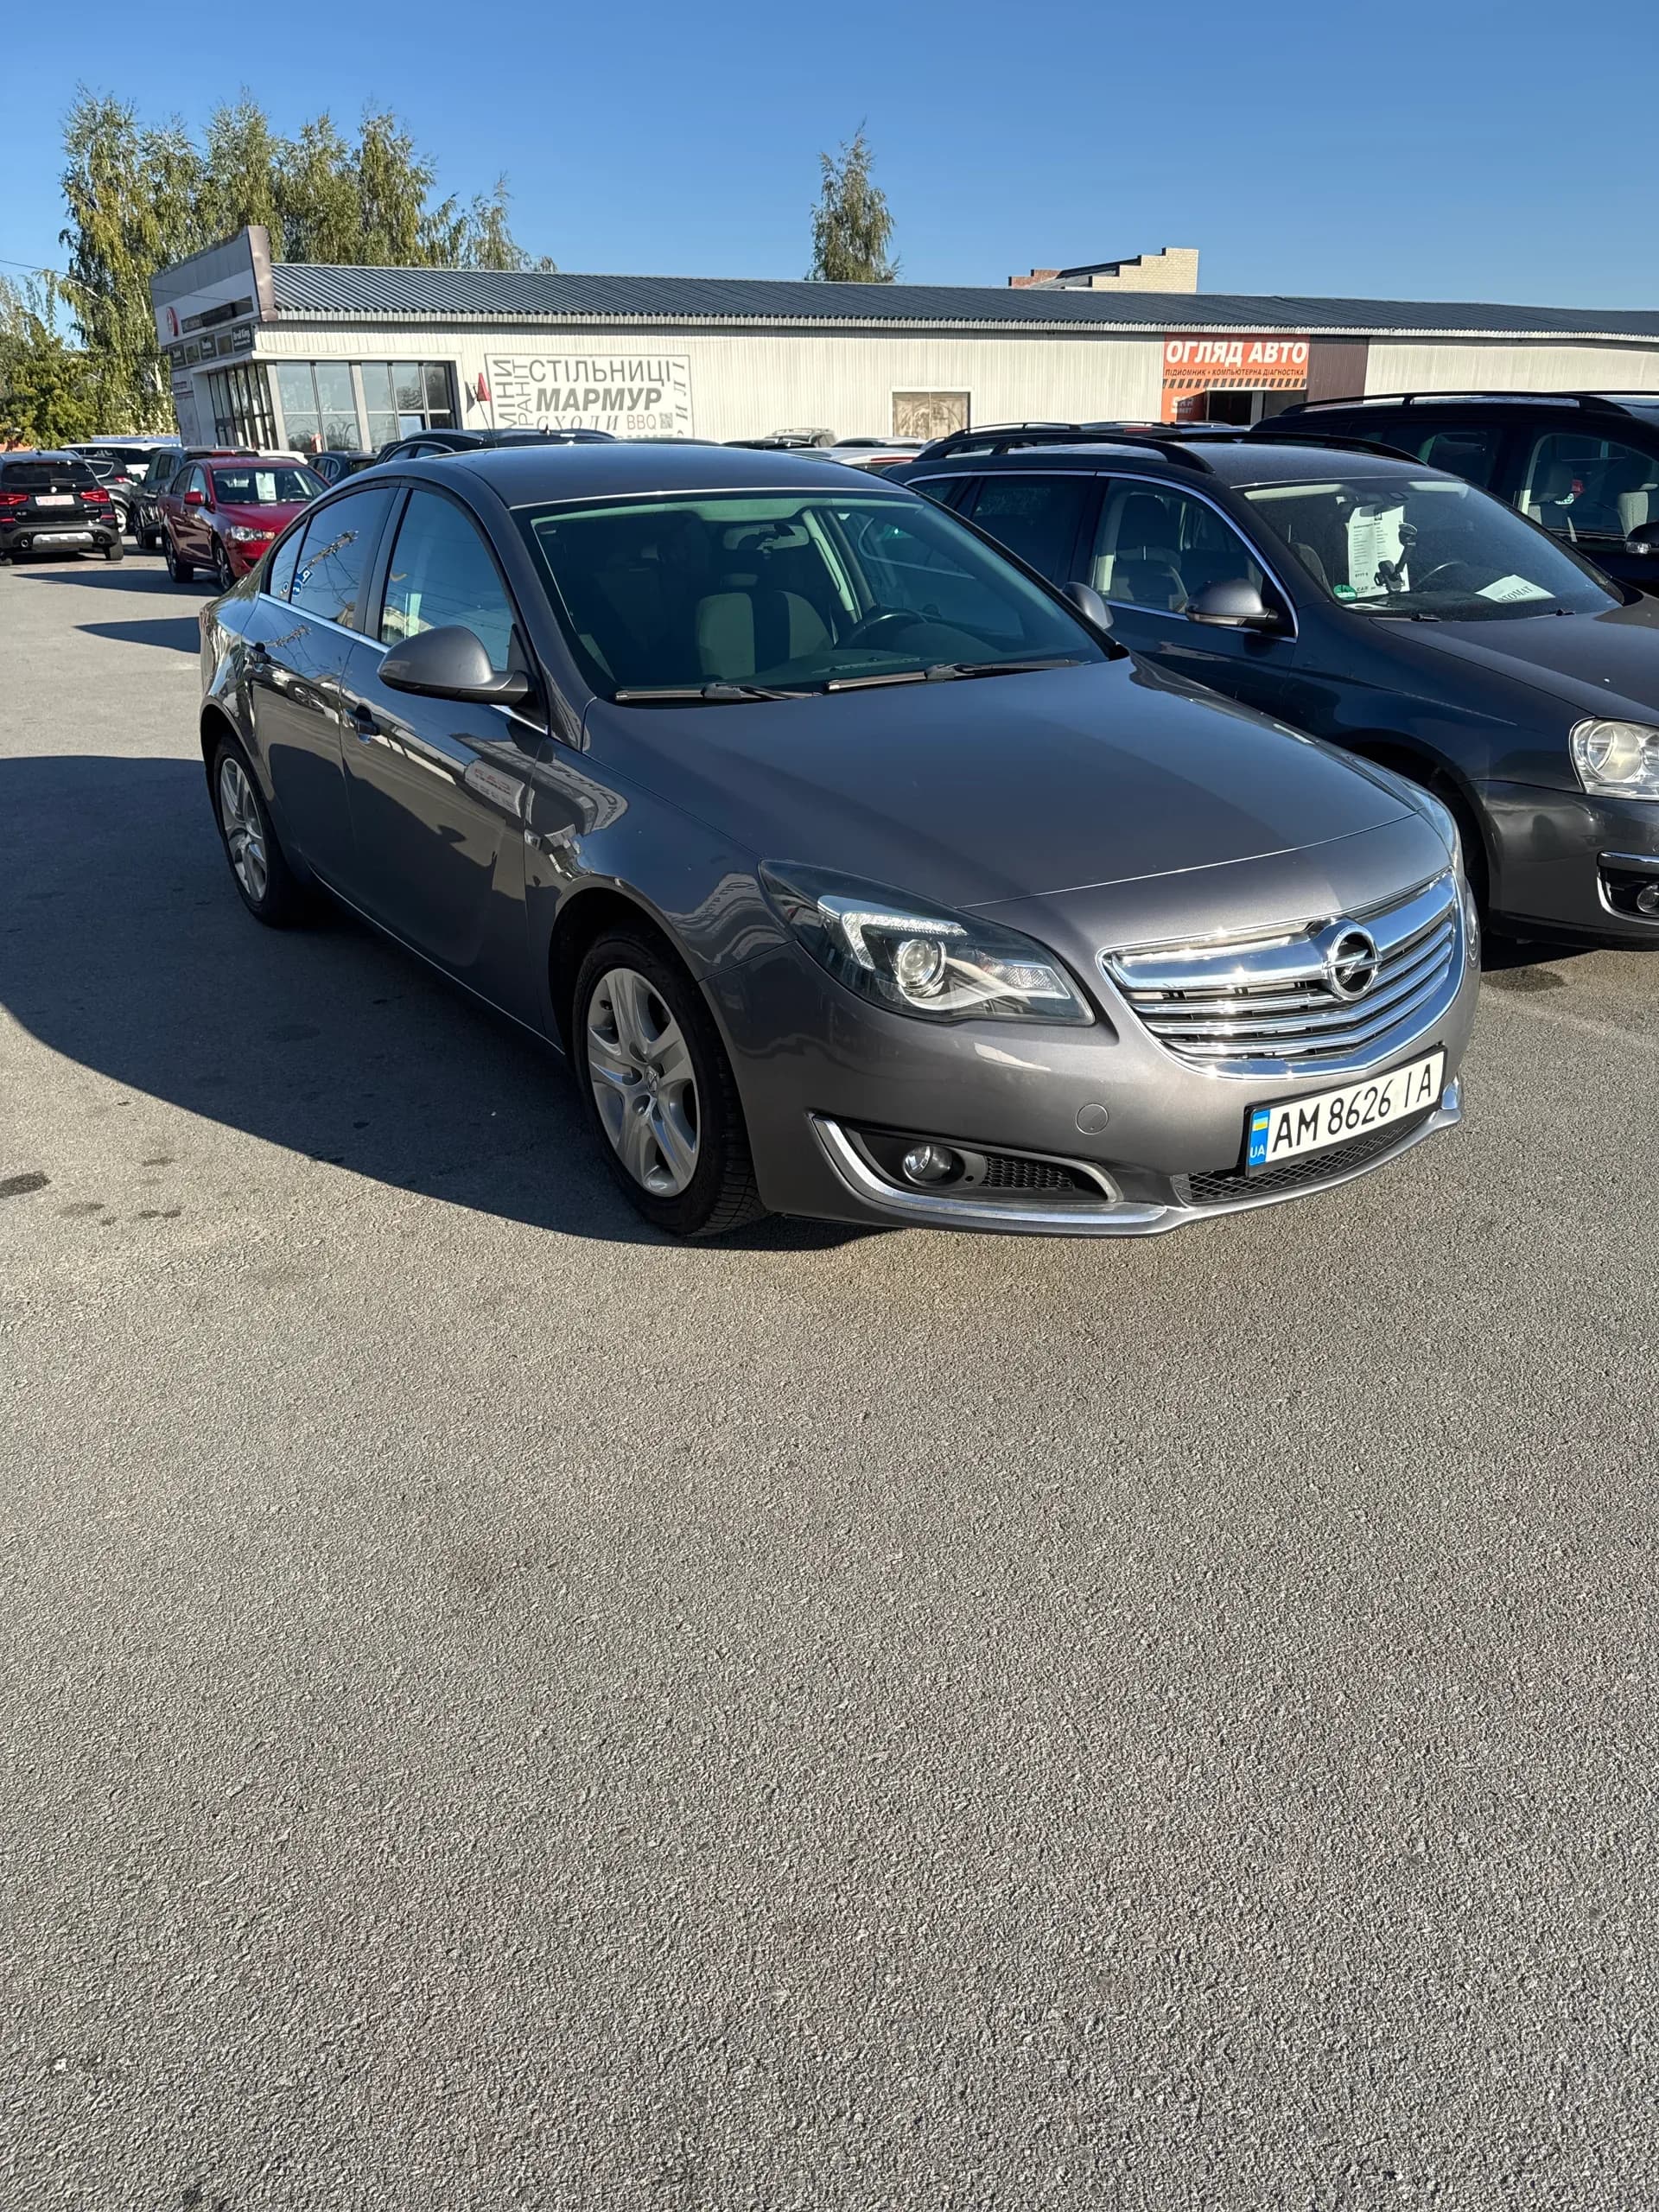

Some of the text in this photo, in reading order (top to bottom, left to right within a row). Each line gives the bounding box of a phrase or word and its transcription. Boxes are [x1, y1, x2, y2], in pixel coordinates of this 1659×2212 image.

[1166, 340, 1307, 367] ОГЛЯД АВТО
[529, 359, 671, 387] СТІЛЬНИЦІ
[536, 388, 662, 411] МАРМУР
[627, 414, 657, 430] BBQ
[1272, 1064, 1432, 1153] AM 8626 IA
[1249, 1144, 1265, 1158] UA
